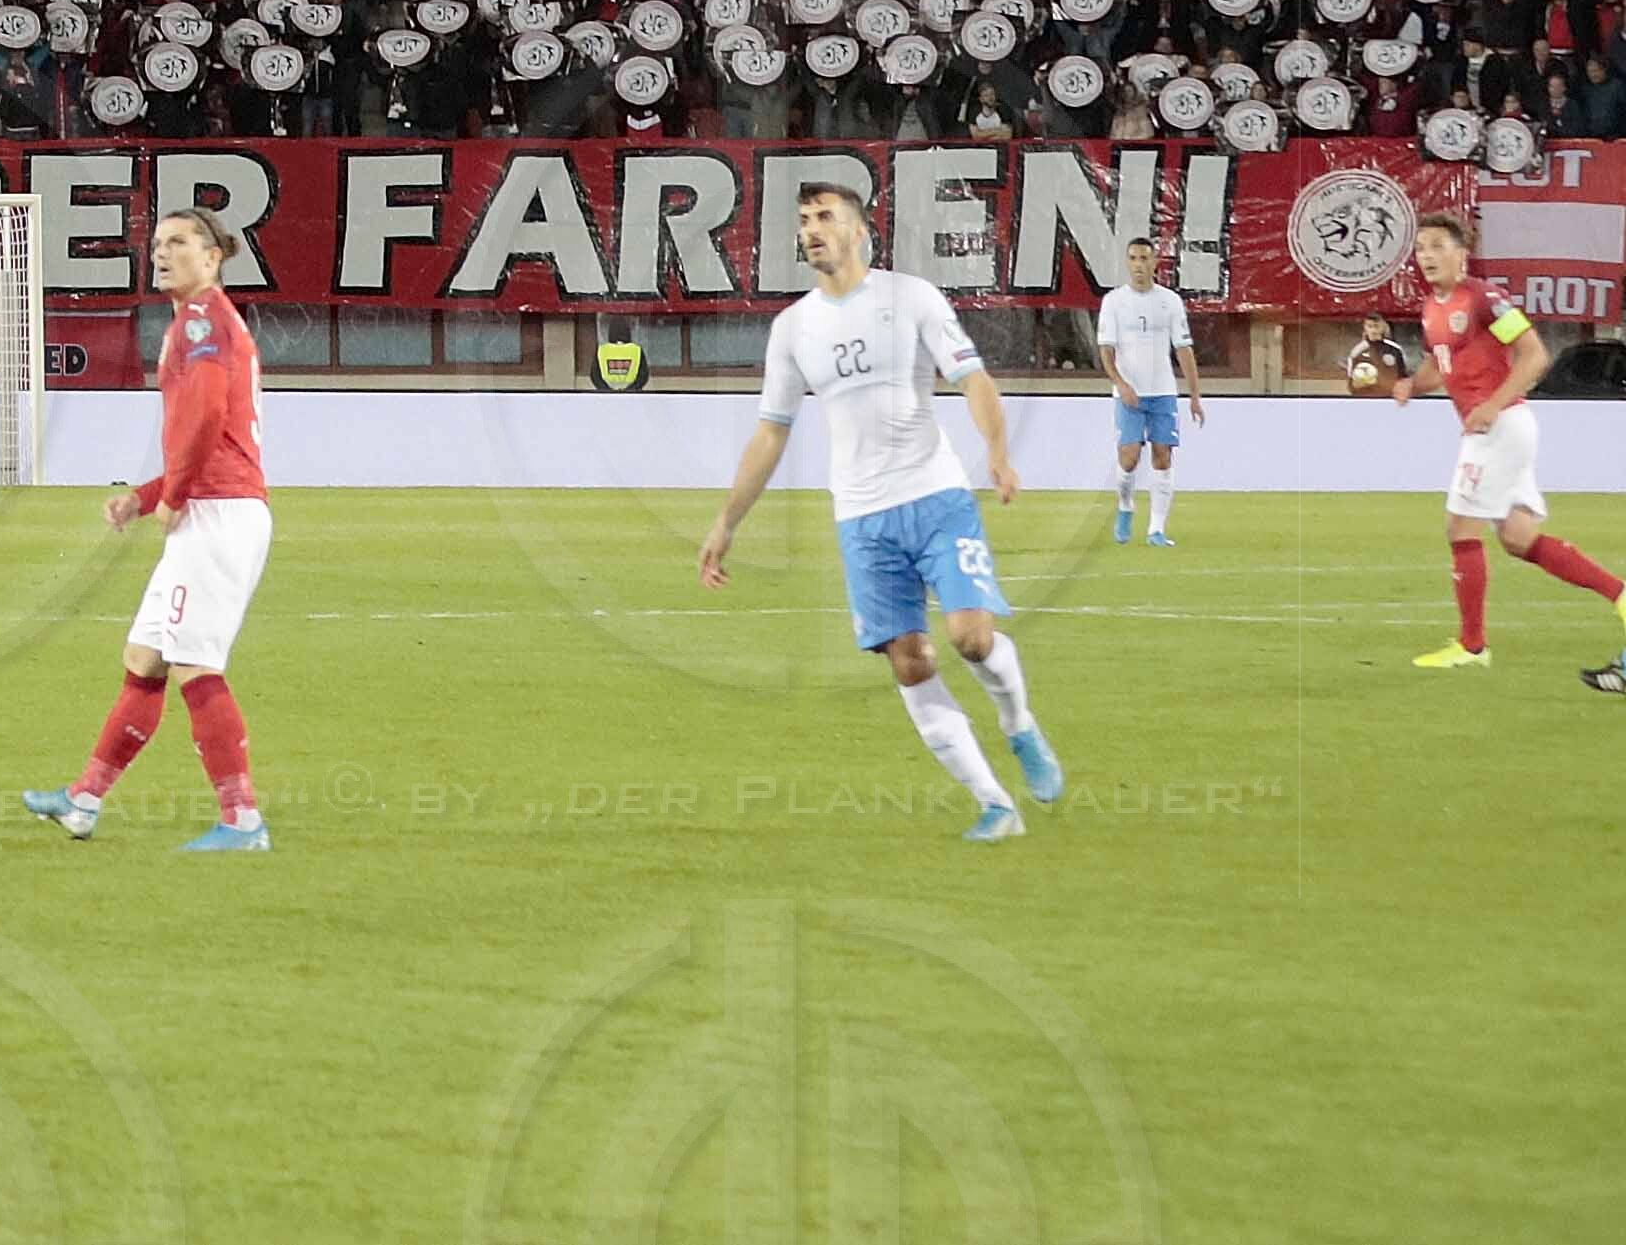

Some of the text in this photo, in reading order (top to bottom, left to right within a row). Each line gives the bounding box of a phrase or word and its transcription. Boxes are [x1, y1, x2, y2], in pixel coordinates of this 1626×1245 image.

[1137, 315, 1147, 333] 7
[833, 338, 873, 378] 22
[955, 537, 993, 577] 22
[168, 584, 187, 625] 9
